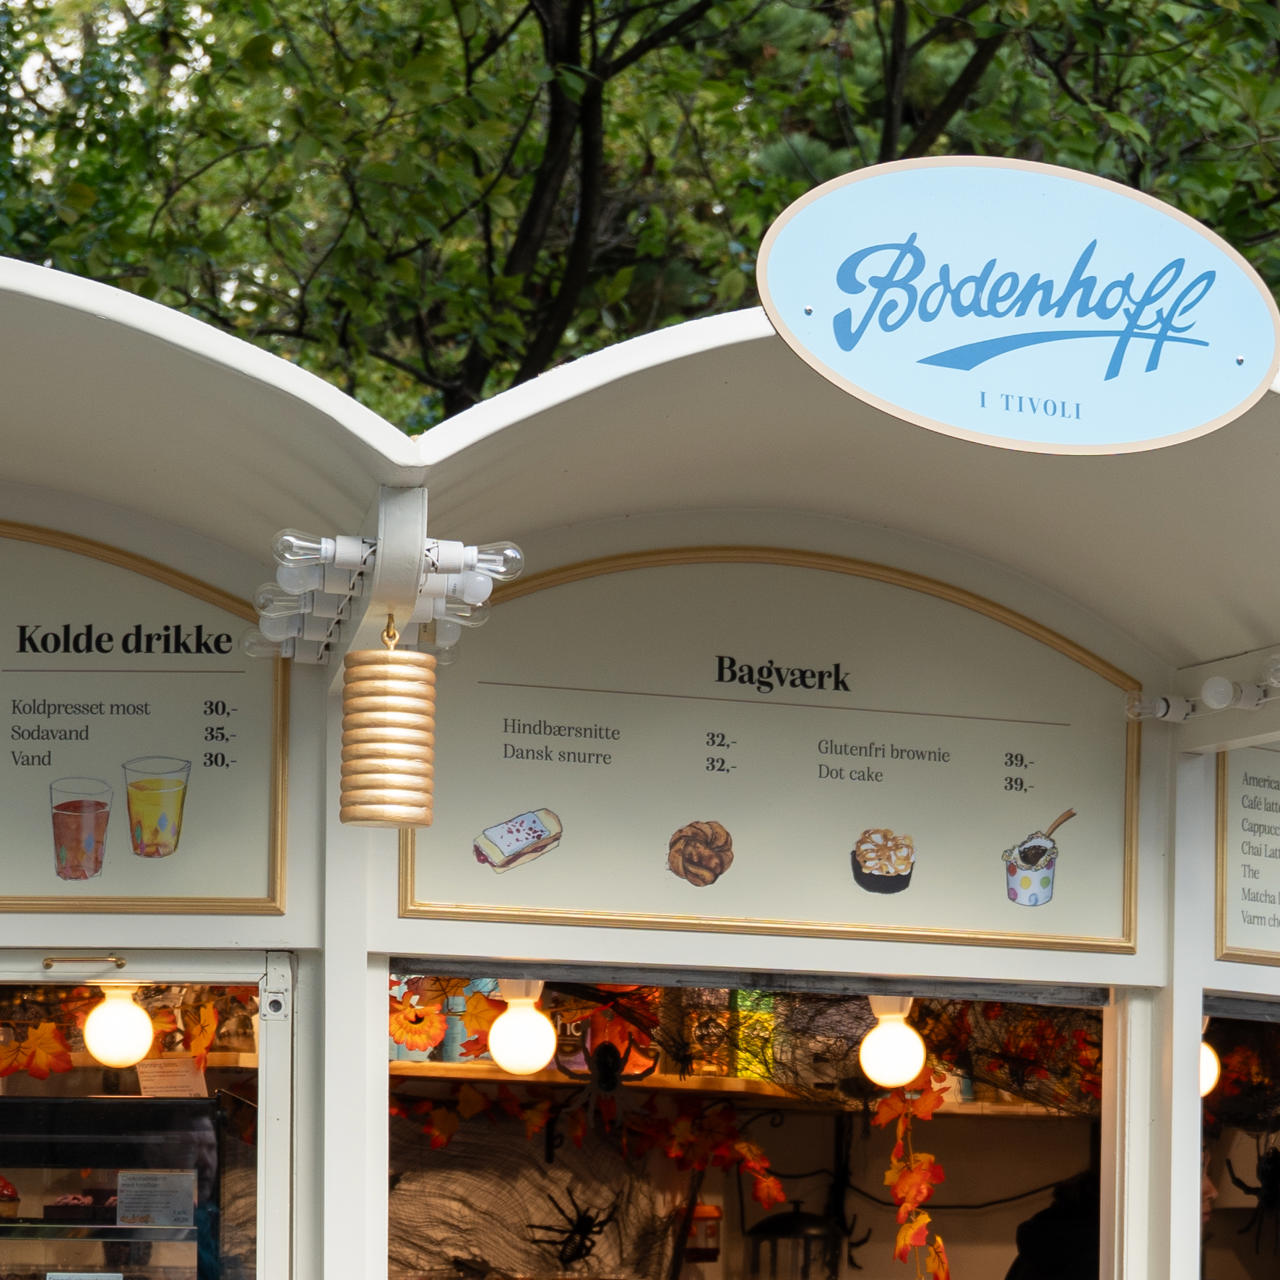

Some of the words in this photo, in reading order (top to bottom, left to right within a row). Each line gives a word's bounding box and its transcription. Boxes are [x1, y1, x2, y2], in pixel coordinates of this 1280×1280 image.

[833, 232, 1216, 381] Bodenhoff
[980, 392, 986, 408] I
[1001, 394, 1083, 420] TIVOLI
[16, 624, 114, 654] Kolde
[122, 624, 232, 654] drikke
[716, 655, 850, 694] Bagværk
[11, 699, 105, 718] Koldpresset
[110, 701, 150, 716] most
[204, 700, 238, 718] 30,-
[11, 725, 88, 741] Sodavand
[204, 727, 237, 743] 35,-
[503, 718, 620, 740] Hindbærsnitte
[706, 732, 737, 749] 32,-
[11, 751, 51, 767] Vand
[503, 744, 553, 762] Dansk
[558, 749, 612, 765] snurre
[818, 739, 885, 759] Glutenfri
[890, 744, 950, 762] brownie
[204, 752, 237, 769] 30,-
[706, 757, 737, 774] 32,-
[1004, 753, 1034, 769] 39,-
[818, 764, 844, 780] Dot
[849, 767, 883, 783] cake
[1004, 777, 1034, 793] 39,-
[1242, 794, 1262, 811] Café
[1241, 841, 1262, 856] Chai
[1241, 864, 1259, 880] The
[1241, 887, 1276, 905] Matcha
[1241, 910, 1266, 927] Varm
